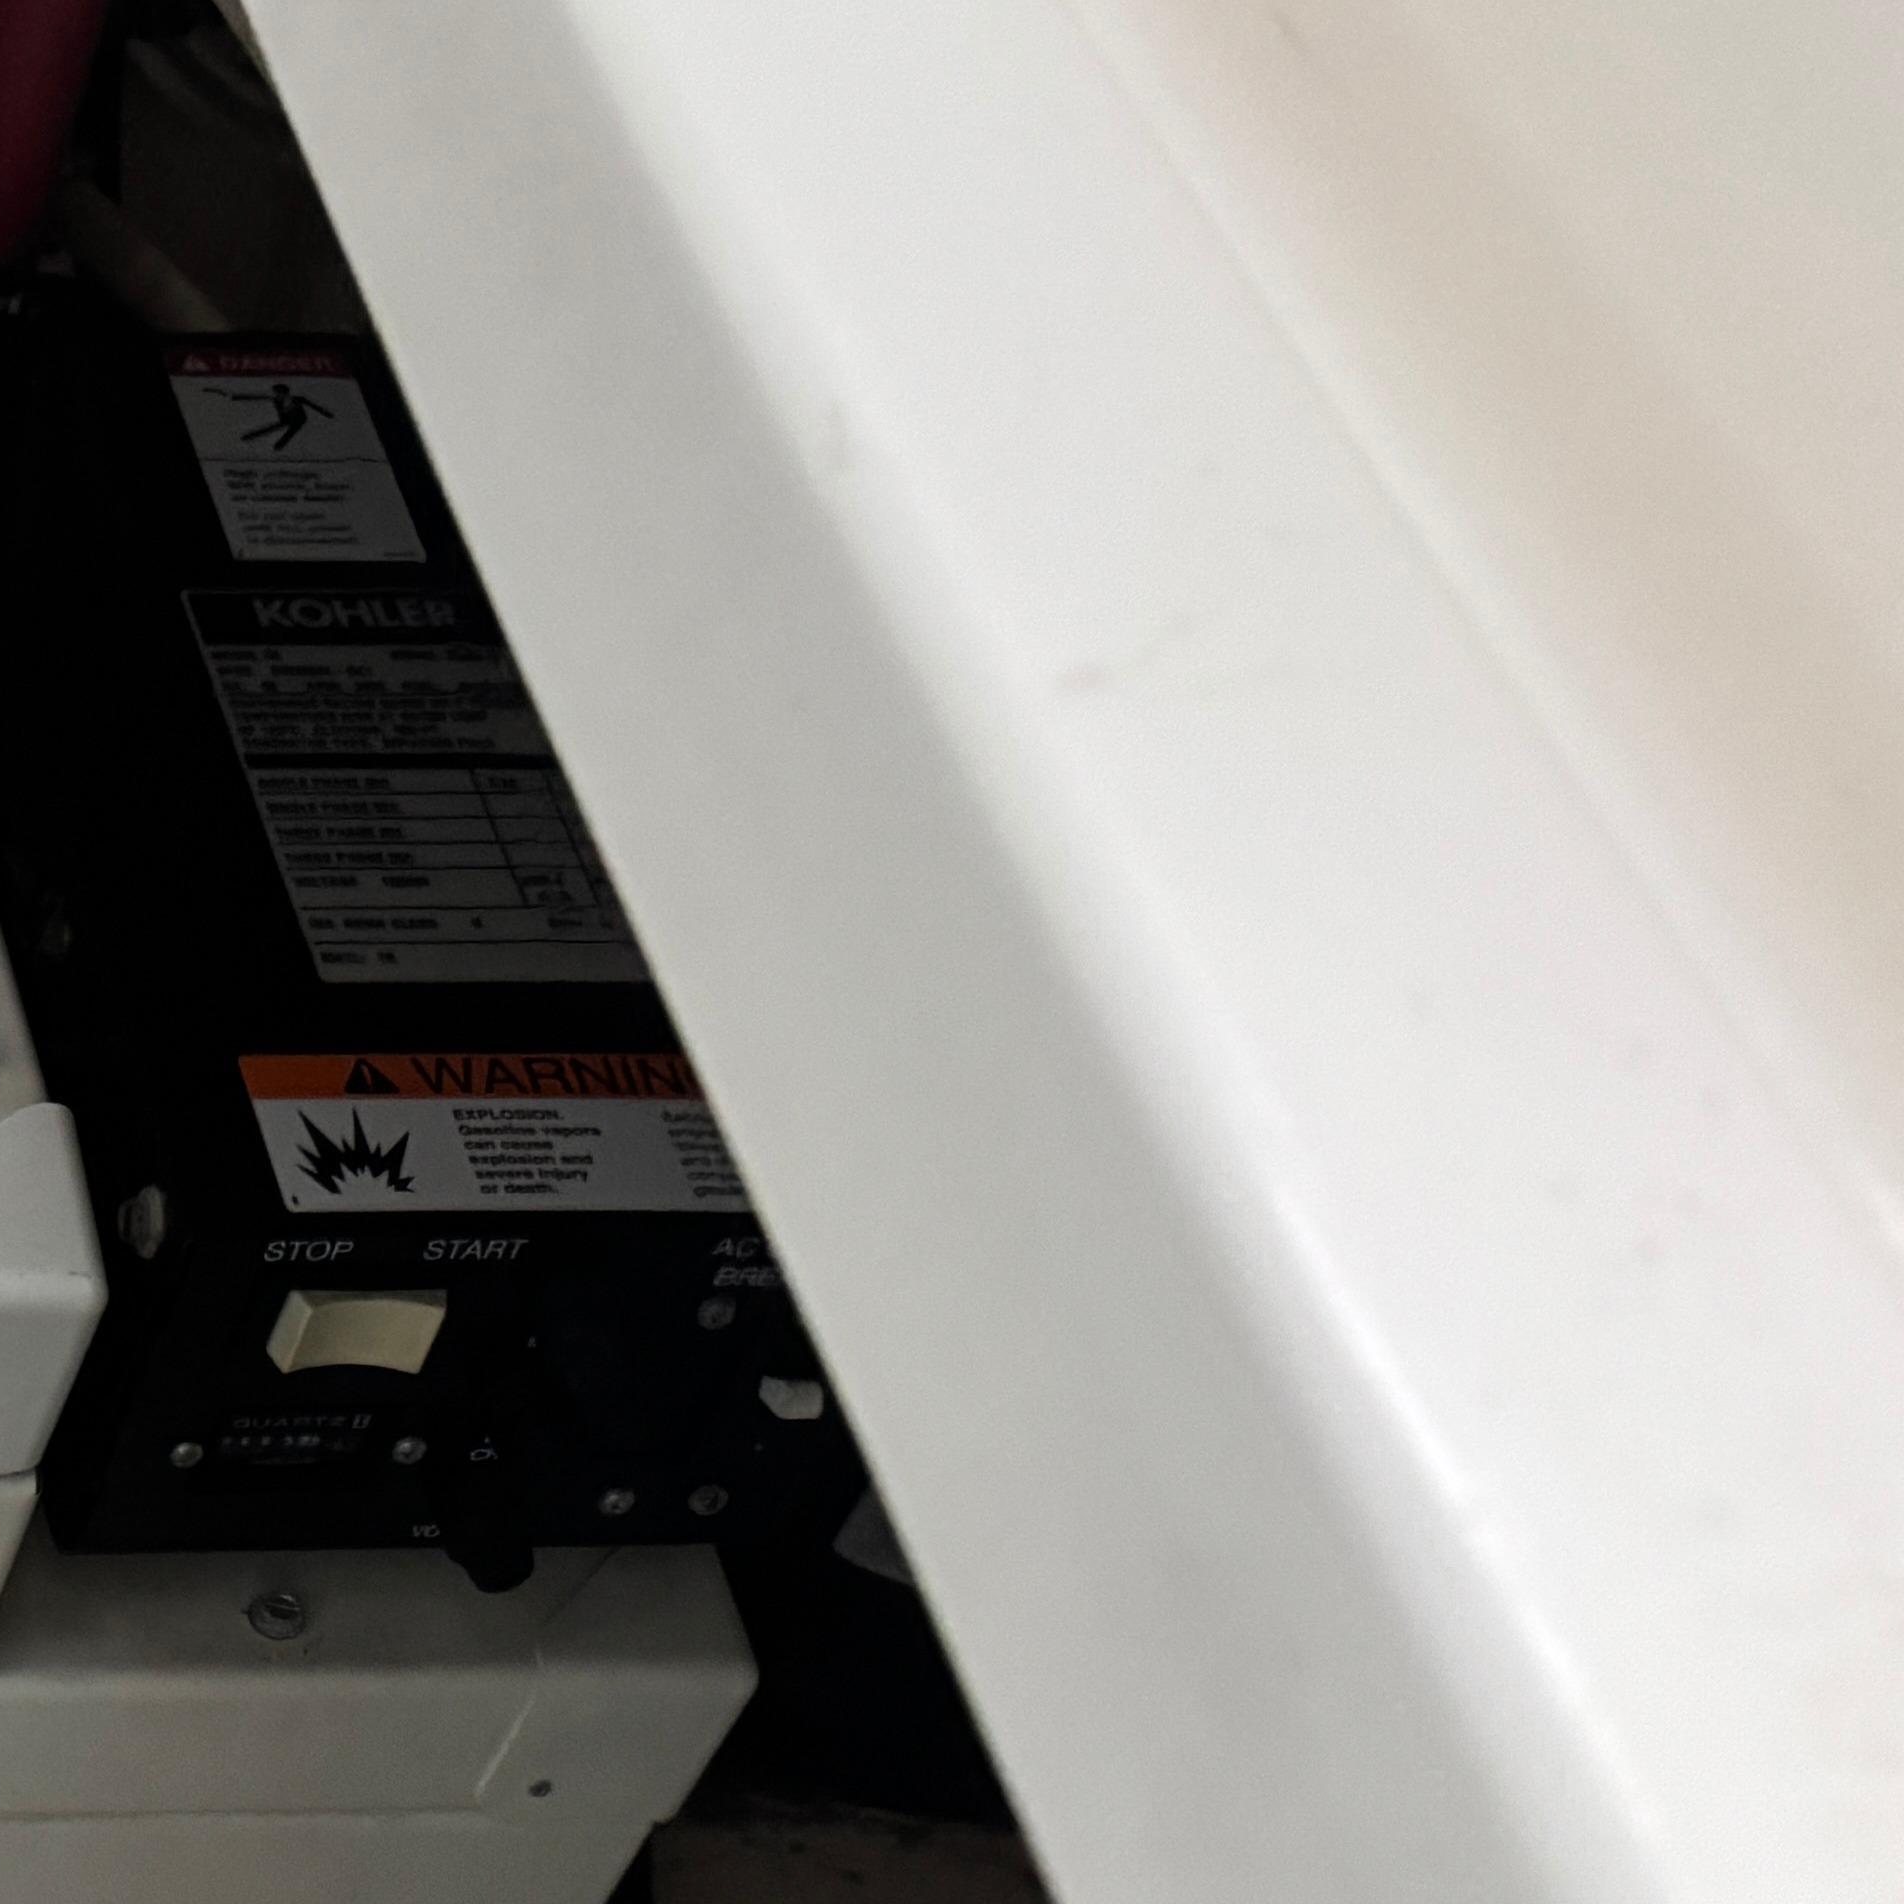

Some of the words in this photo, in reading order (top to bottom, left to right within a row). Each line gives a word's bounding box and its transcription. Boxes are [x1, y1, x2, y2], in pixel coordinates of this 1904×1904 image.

[252, 599, 455, 628] KOHLER
[411, 1056, 698, 1096] WARNIN
[263, 1239, 355, 1262] STOP
[422, 1238, 530, 1261] START
